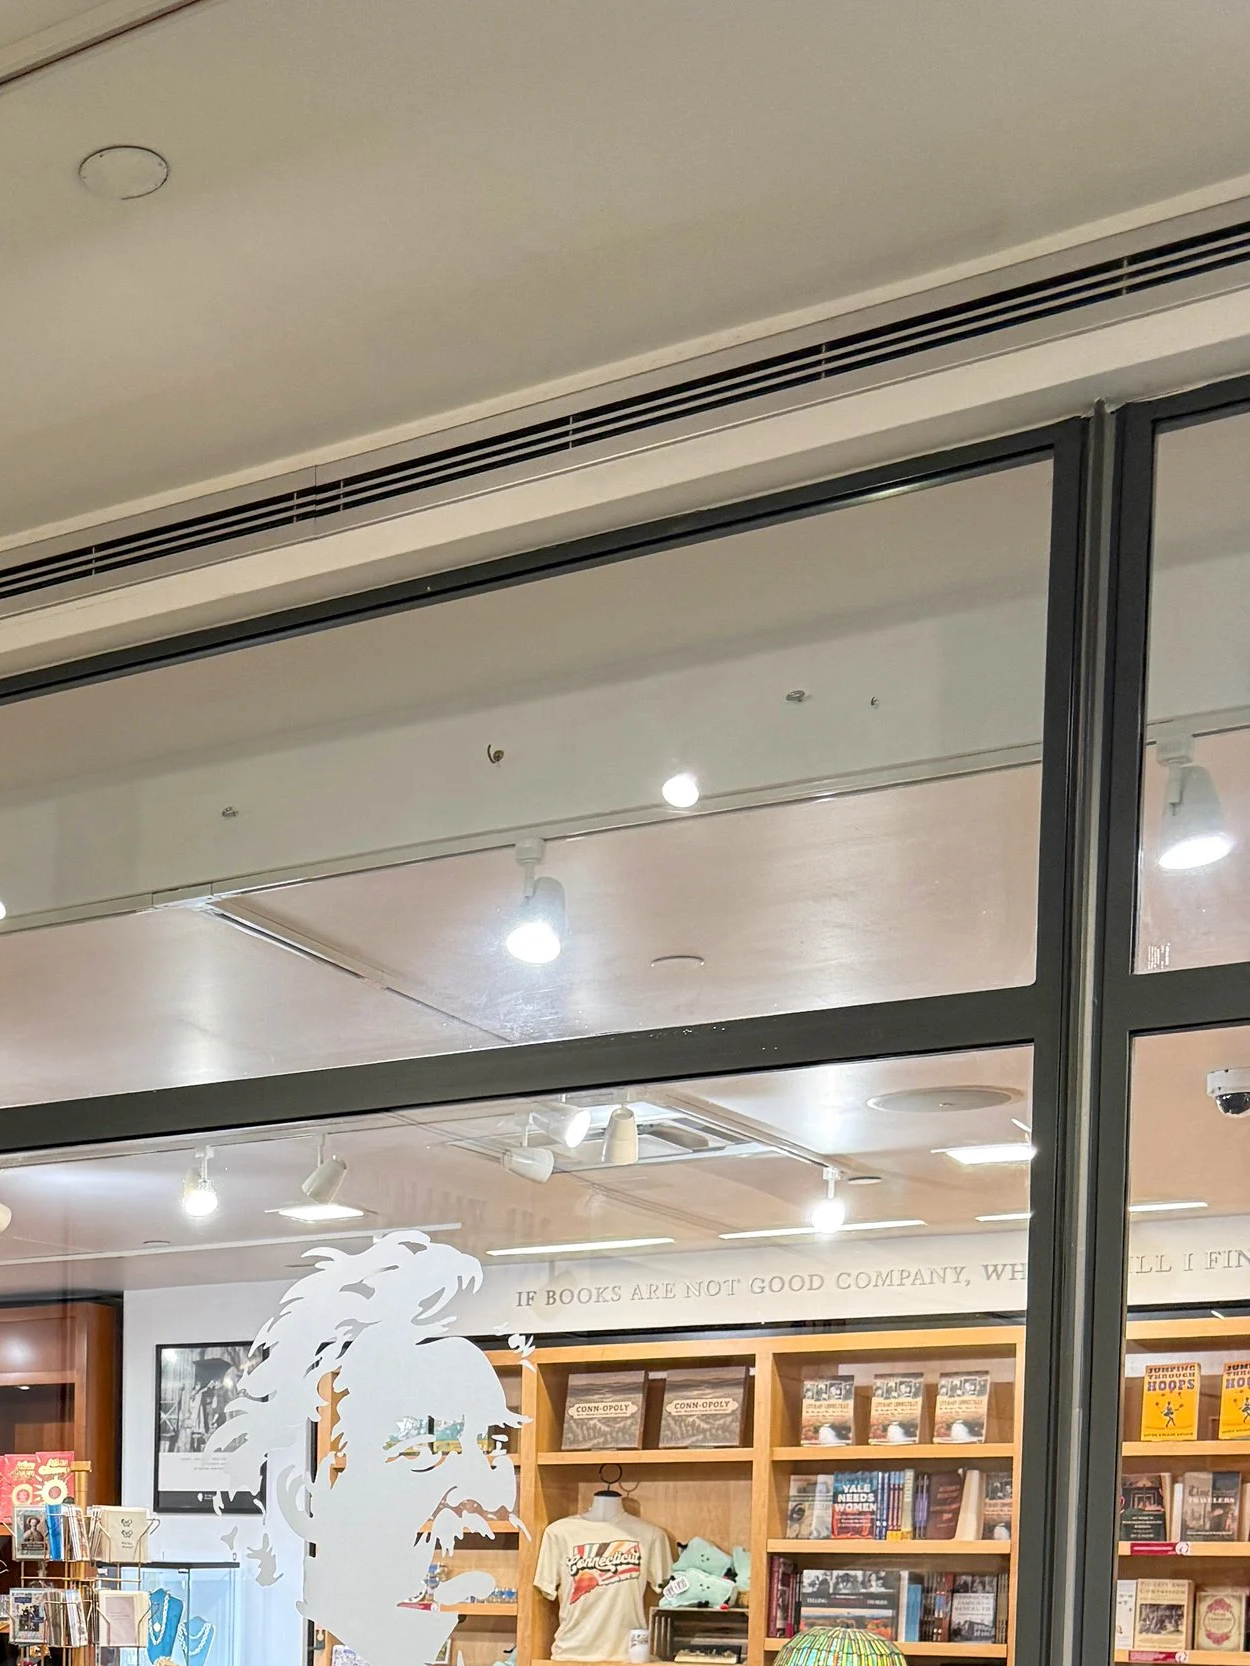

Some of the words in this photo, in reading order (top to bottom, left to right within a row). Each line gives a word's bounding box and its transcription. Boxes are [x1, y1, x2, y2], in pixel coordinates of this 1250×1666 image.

[515, 1290, 536, 1308] IF
[544, 1285, 622, 1307] BOOKS
[631, 1282, 676, 1302] ARE
[684, 1278, 739, 1299] NOT
[749, 1273, 825, 1296] GOOD
[836, 1266, 973, 1292] COMPANY,
[981, 1262, 1027, 1282] WH
[1182, 1252, 1194, 1273] I
[1204, 1249, 1250, 1271] FIN
[1148, 1372, 1196, 1380] THROUGH
[1147, 1379, 1196, 1392] HOOPS
[576, 1403, 630, 1413] CONN-OPOLY
[674, 1400, 730, 1410] CONN-OPOLY
[842, 1483, 871, 1493] YALE
[837, 1493, 875, 1503] NEEDS
[834, 1502, 877, 1512] WOMEN
[566, 1548, 642, 1577] Connecticut
